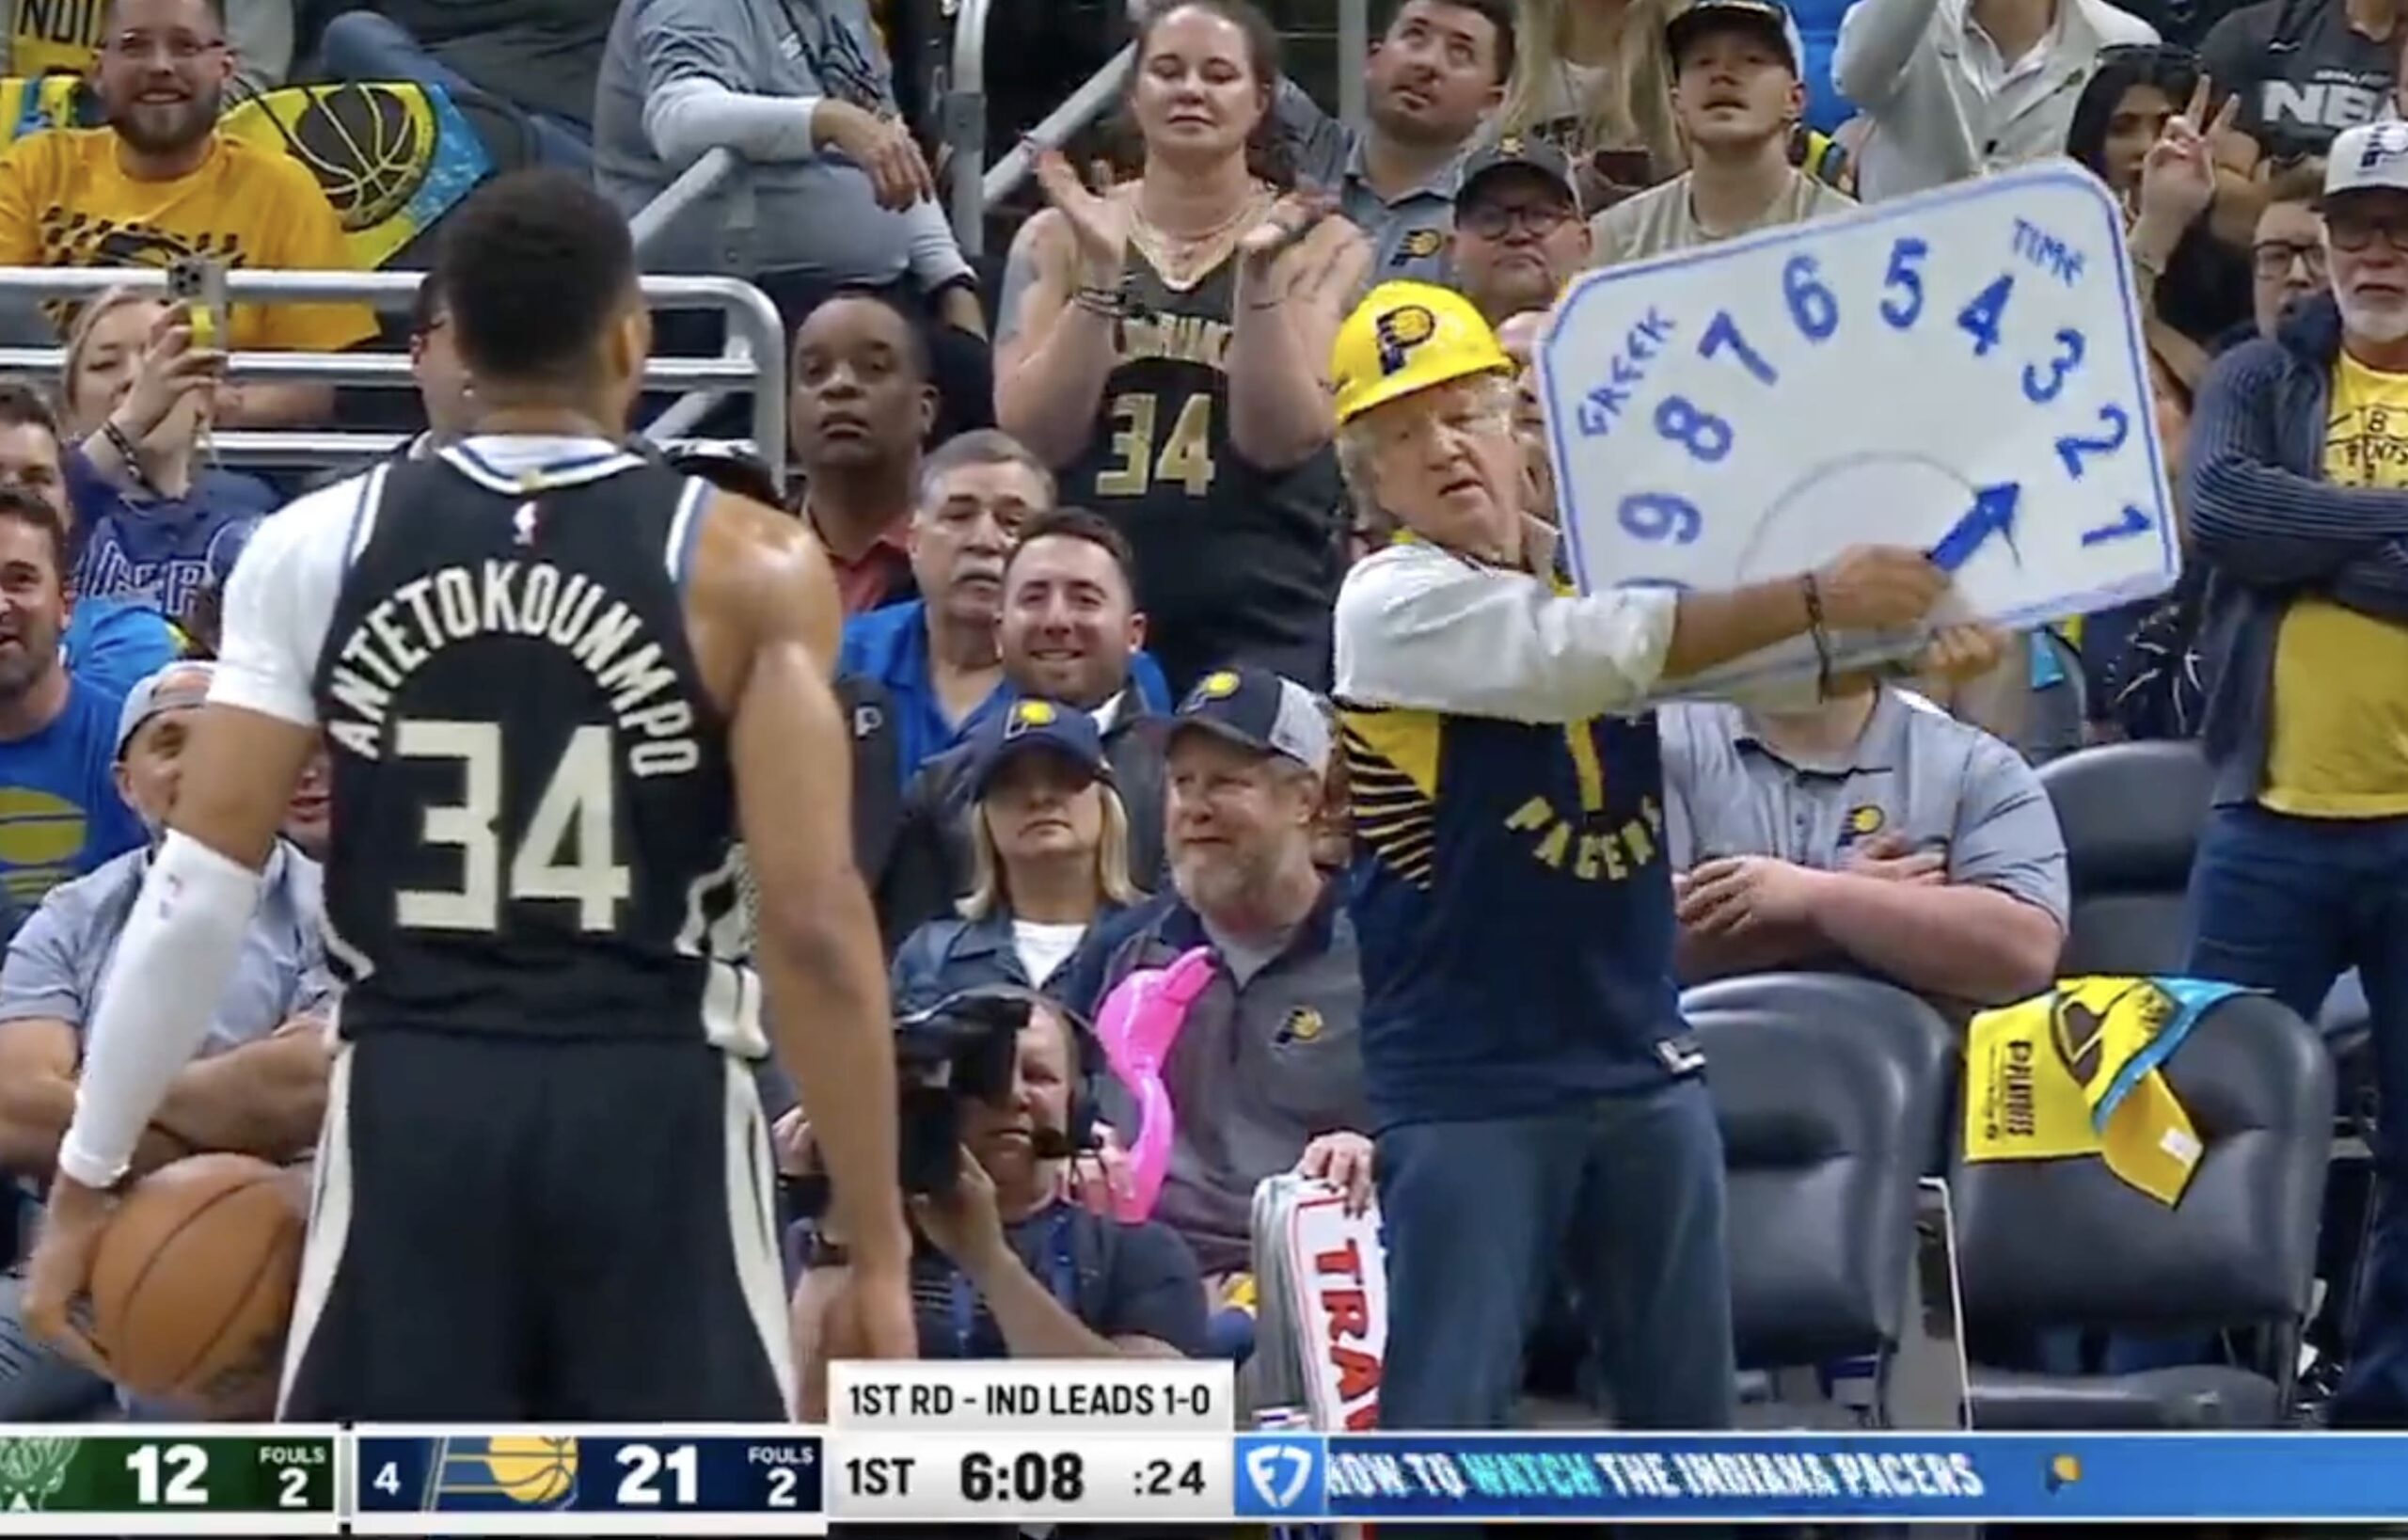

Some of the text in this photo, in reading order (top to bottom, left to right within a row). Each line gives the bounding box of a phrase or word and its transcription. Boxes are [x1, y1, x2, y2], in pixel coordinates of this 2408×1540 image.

[1782, 254, 1840, 344] 6
[1879, 237, 1928, 329] 5
[1956, 275, 2015, 357] 4
[1697, 310, 1780, 387] 7
[2022, 327, 2085, 405] 3
[1095, 393, 1215, 497] 34
[1654, 394, 1735, 463] 8
[2054, 405, 2130, 482] 2
[2082, 504, 2154, 548] 1
[328, 557, 699, 779] ANTETOKOUNMPO
[395, 720, 631, 932] 34
